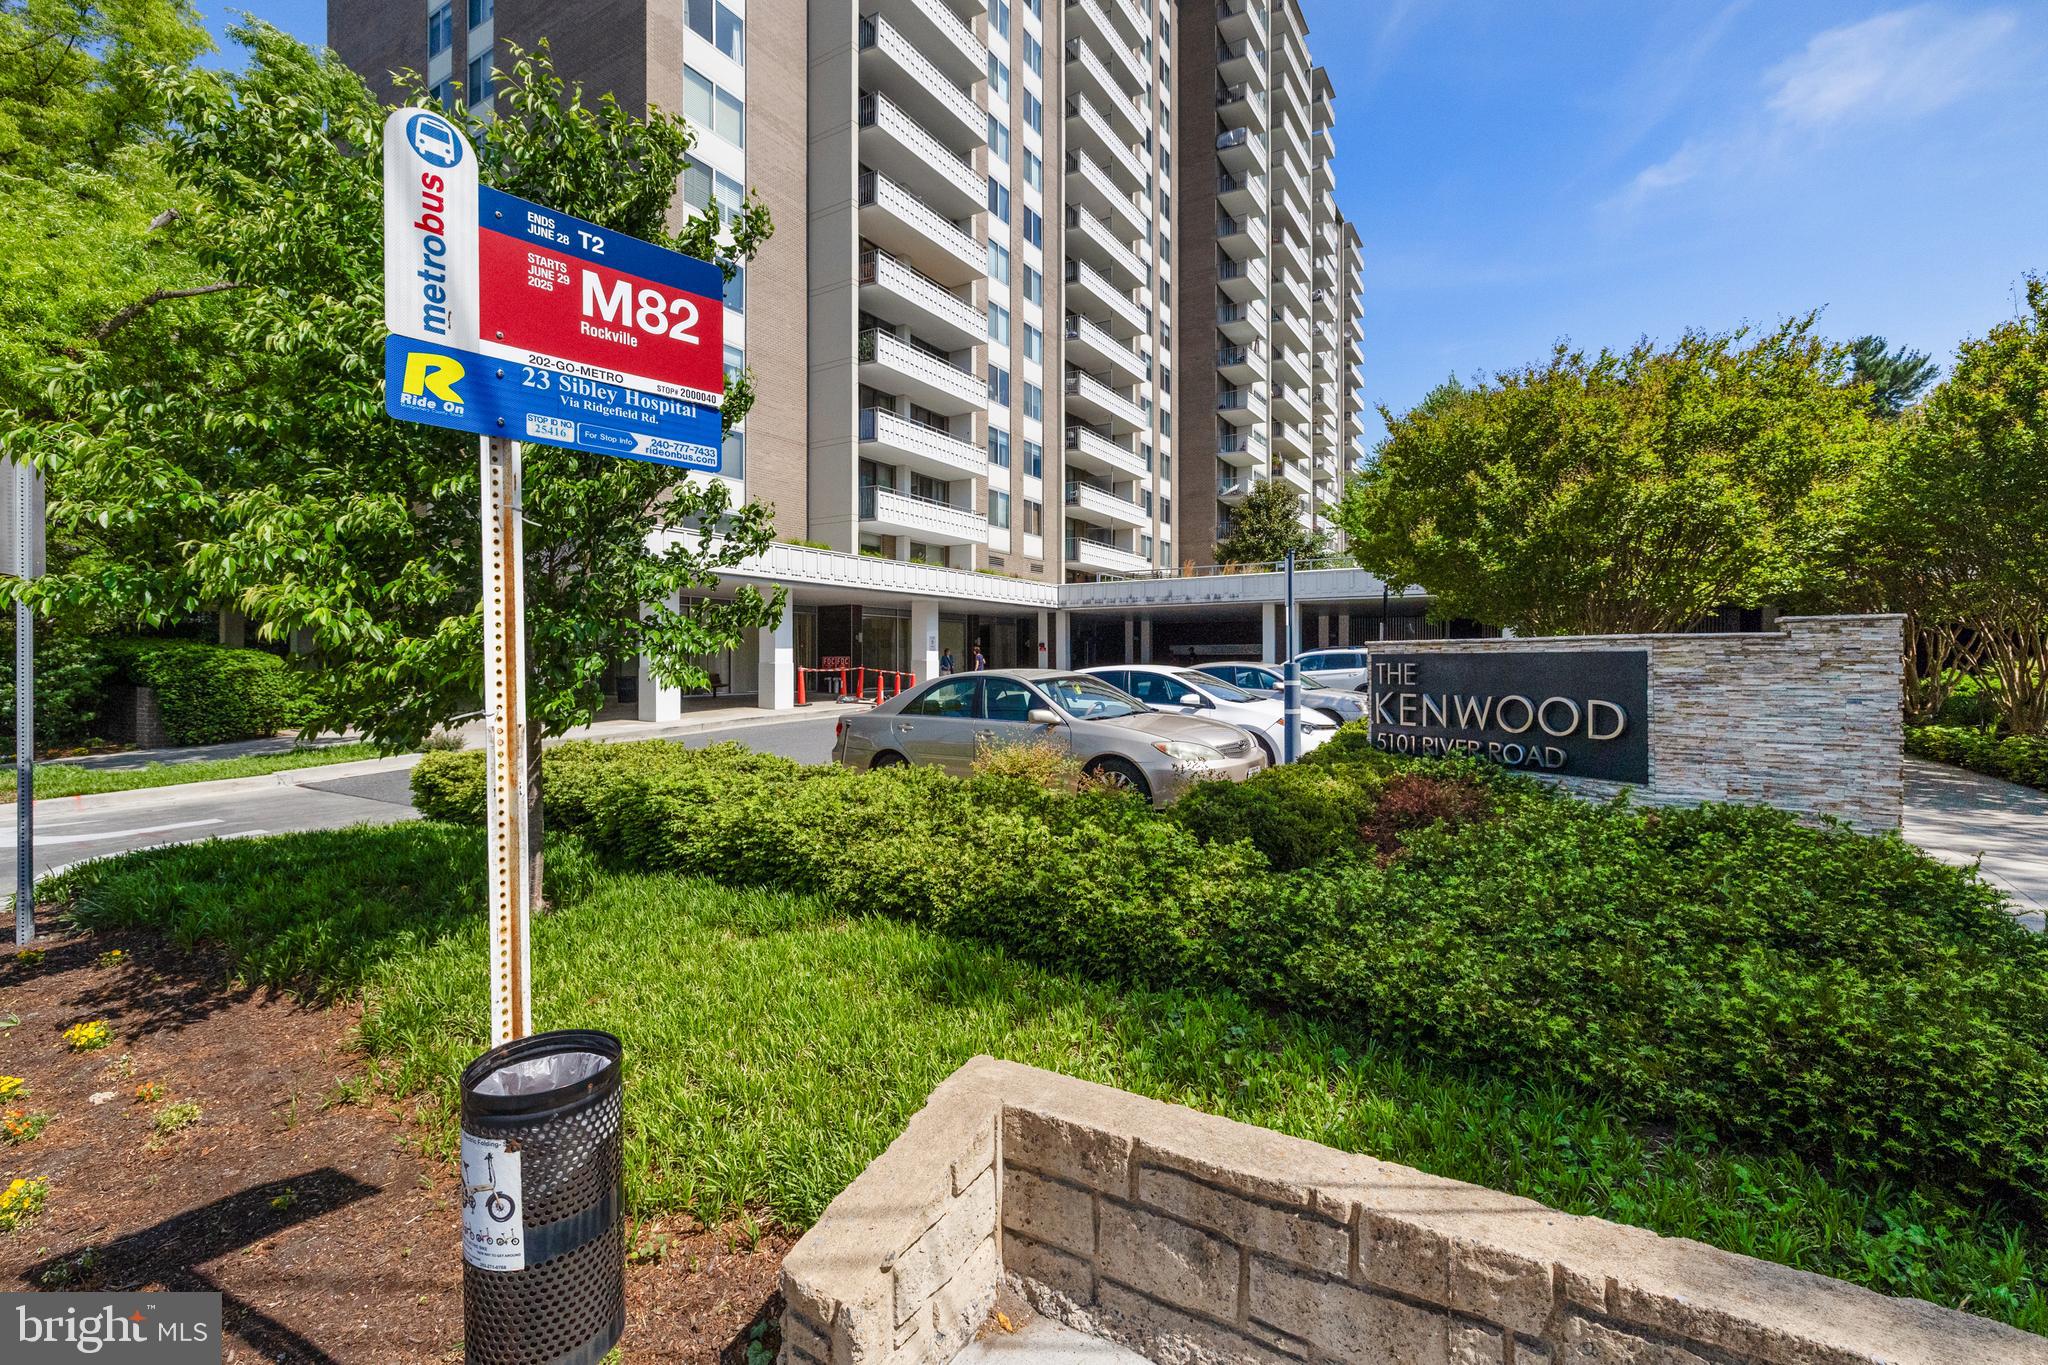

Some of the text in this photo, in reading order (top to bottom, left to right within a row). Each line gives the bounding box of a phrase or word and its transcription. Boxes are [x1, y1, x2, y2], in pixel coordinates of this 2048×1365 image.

[527, 211, 555, 230] ENDS
[527, 223, 570, 246] JUNE 28
[577, 230, 605, 255] T2
[414, 172, 447, 335] metrobus
[527, 252, 567, 273] STARTS
[527, 264, 570, 285] JUNE 29
[527, 276, 553, 292] 2025
[581, 268, 700, 346] M82
[580, 320, 638, 348] Rockville
[528, 353, 624, 384] 202-GO-METRO
[400, 392, 437, 409] Ride
[443, 401, 464, 414] On
[522, 366, 697, 419] 23 Sibley Hospital
[656, 384, 717, 404] STOP# 2000040
[560, 394, 659, 425] Via Ridgefield Rd.
[527, 414, 574, 430] STOP ID NO.
[534, 424, 567, 438] 25416
[584, 430, 633, 446] For Stop Info
[650, 438, 716, 458] 240-777-7433
[645, 446, 716, 465] rideonbus.com
[1375, 662, 1417, 686] THE
[1375, 692, 1626, 740] KENWOOD
[1377, 732, 1566, 768] 5101 RIVER ROAD
